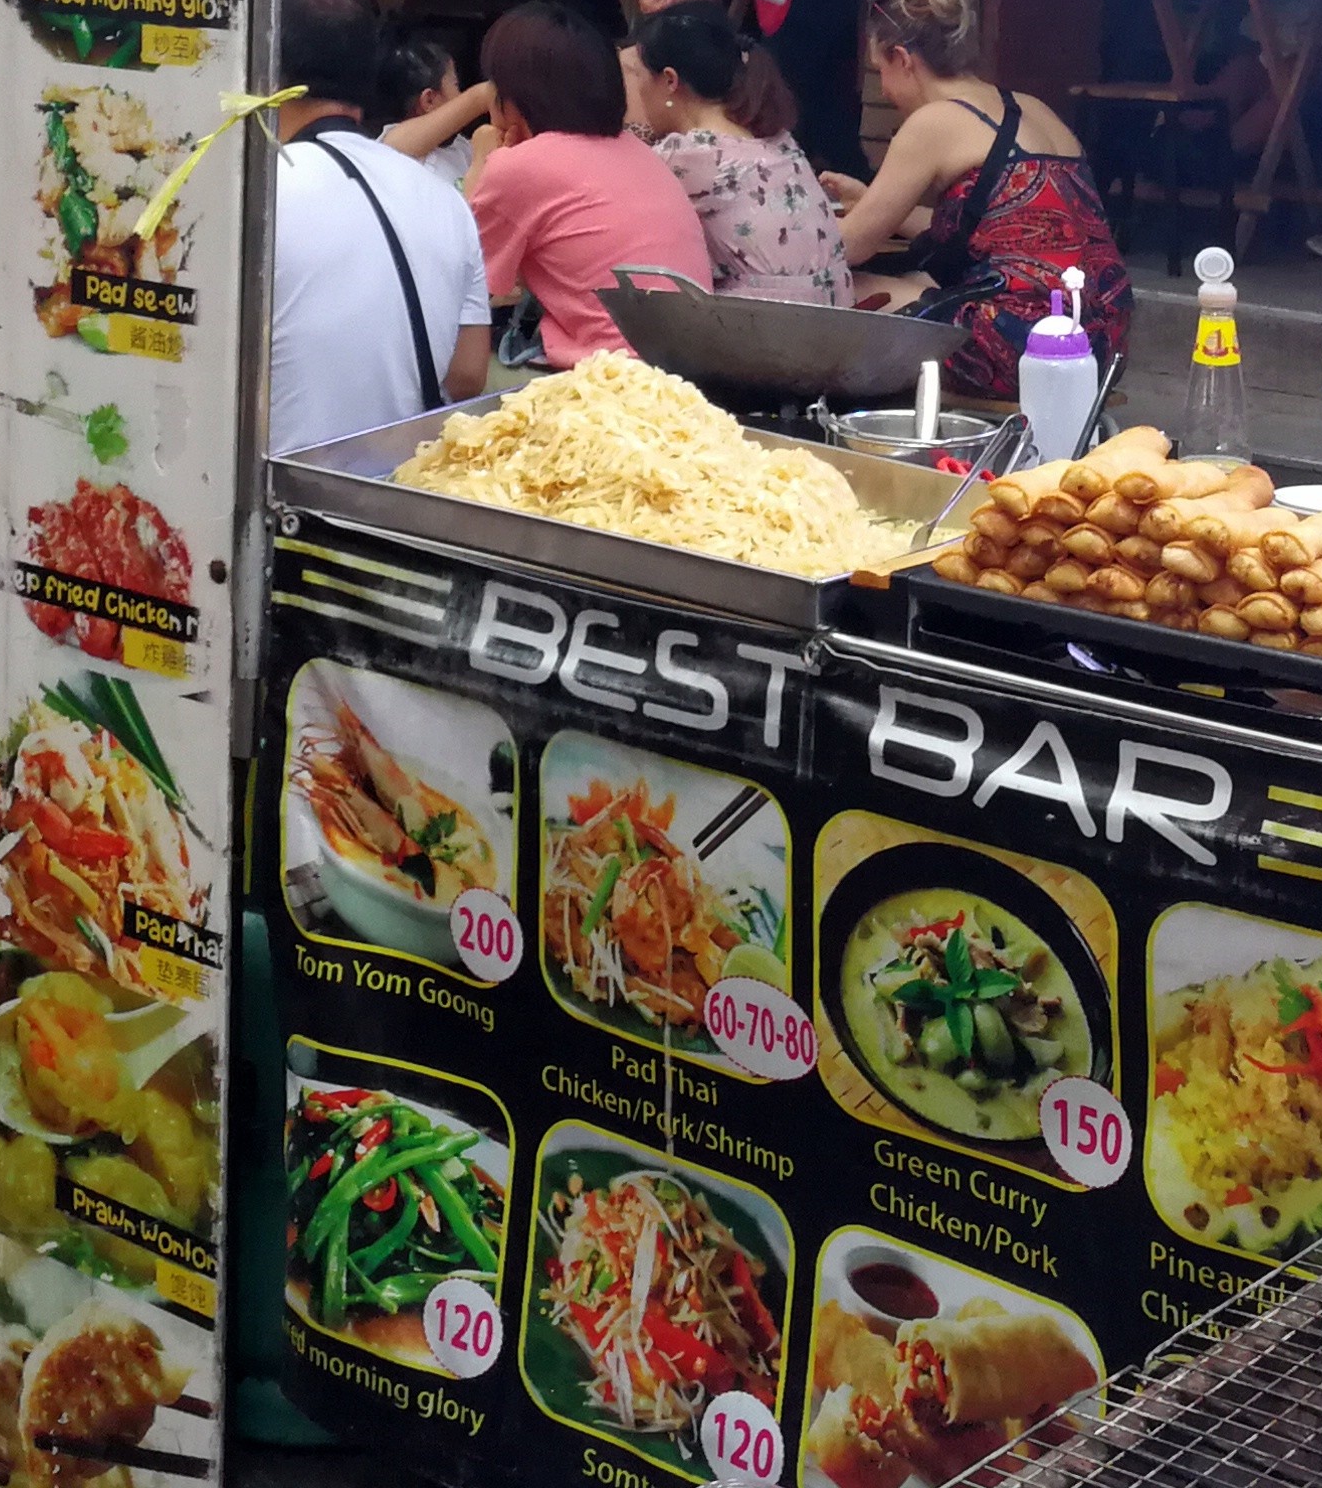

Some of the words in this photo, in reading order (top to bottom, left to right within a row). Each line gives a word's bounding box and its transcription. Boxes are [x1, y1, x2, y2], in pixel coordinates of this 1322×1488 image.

[86, 275, 127, 309] Pad
[133, 287, 198, 316] se-ew
[44, 575, 100, 612] fried
[105, 591, 182, 635] Chicken
[469, 578, 821, 748] BEST
[868, 683, 1234, 867] BAR
[136, 909, 178, 948] Pad
[458, 905, 515, 963] 200
[294, 943, 344, 984] Tom
[352, 962, 413, 997] Yom
[418, 976, 495, 1032] Goong
[708, 990, 814, 1065] 60-70-80
[610, 1044, 657, 1085] Pad
[655, 1064, 719, 1107] Thai
[541, 1064, 796, 1182] Chicken/Pork/Shrimp
[1052, 1098, 1123, 1166] 150
[73, 1187, 136, 1236] Prawn
[874, 1139, 961, 1192] Green
[968, 1170, 1047, 1228] Curry
[869, 1182, 1059, 1279] Chicken/Pork
[436, 1298, 494, 1358] 120
[309, 1346, 411, 1410] morning
[417, 1386, 486, 1438] glory
[713, 1411, 775, 1478] 120
